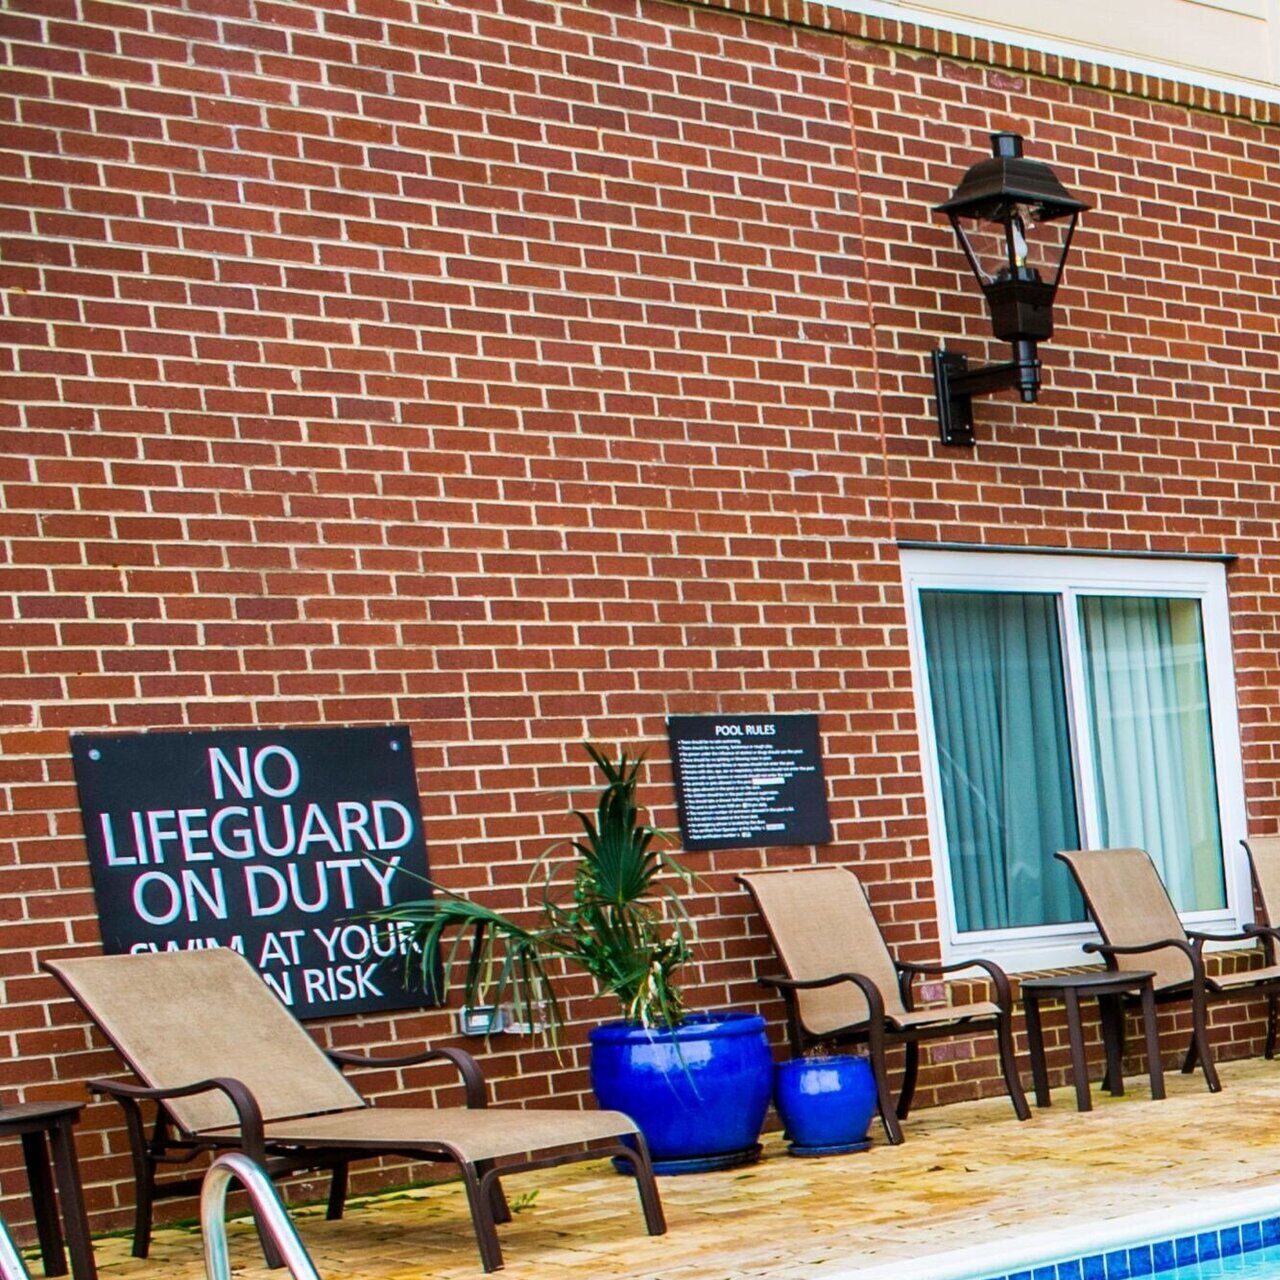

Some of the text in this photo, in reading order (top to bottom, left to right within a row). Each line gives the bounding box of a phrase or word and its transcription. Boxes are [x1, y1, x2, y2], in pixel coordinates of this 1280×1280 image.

[715, 724, 776, 736] POOL RULES
[208, 745, 300, 800] NO
[101, 800, 414, 867] LIFEGUARD
[132, 856, 402, 925] ON DUTY
[259, 930, 306, 968] AT
[312, 921, 422, 962] YOUR
[302, 962, 385, 1004] RISK
